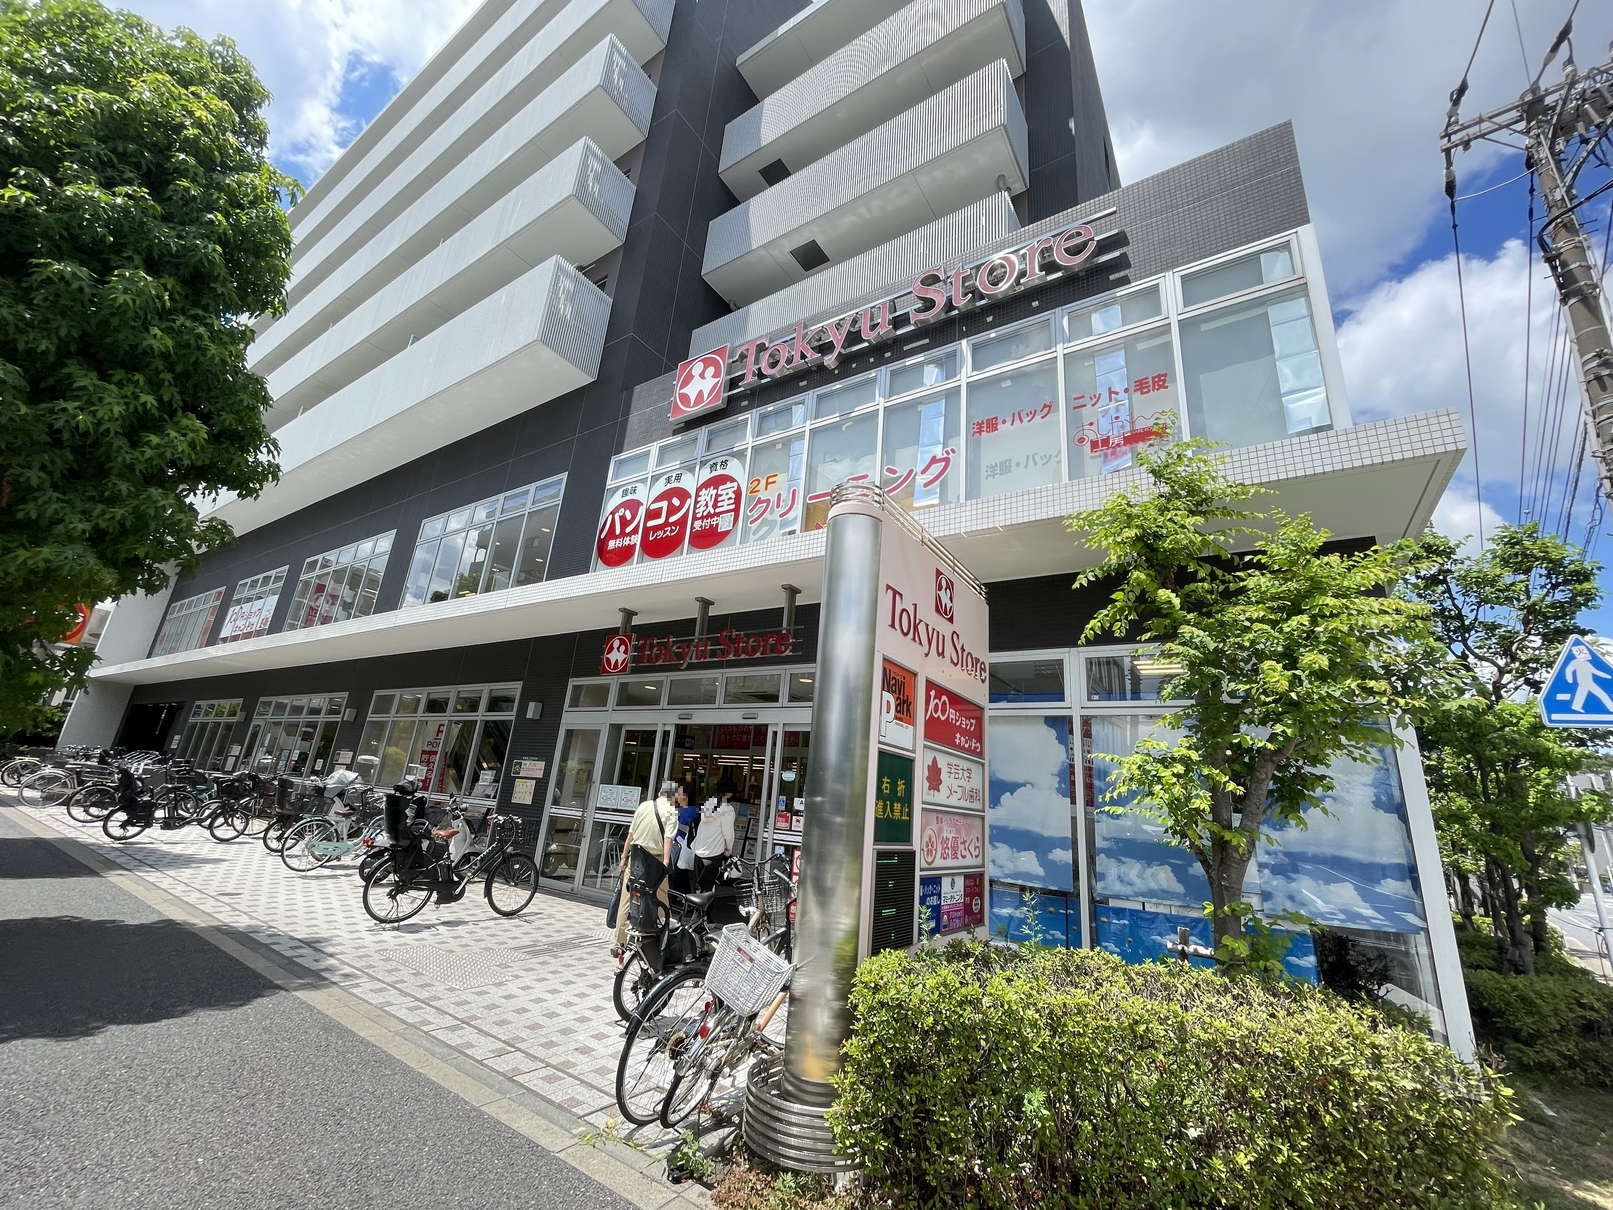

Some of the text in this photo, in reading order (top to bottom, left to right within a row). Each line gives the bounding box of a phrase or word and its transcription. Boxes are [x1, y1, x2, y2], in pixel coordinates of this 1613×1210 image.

[739, 223, 1098, 384] Tokyu Store
[1072, 373, 1169, 411] ニット・毛皮
[972, 401, 1055, 438] 洋服・バッグ
[664, 472, 683, 487] 実用
[709, 459, 729, 474] 資格
[749, 473, 779, 495] 2F
[649, 526, 680, 541] レッスン
[692, 516, 720, 532] 受付中
[637, 627, 793, 669] Tokyu Store
[885, 584, 987, 684] Tokyu Store
[882, 666, 906, 698] Navi
[880, 690, 912, 737] Park
[926, 689, 977, 732] 100円ショップ
[881, 776, 906, 798] 右折
[874, 800, 910, 821] 進入禁止
